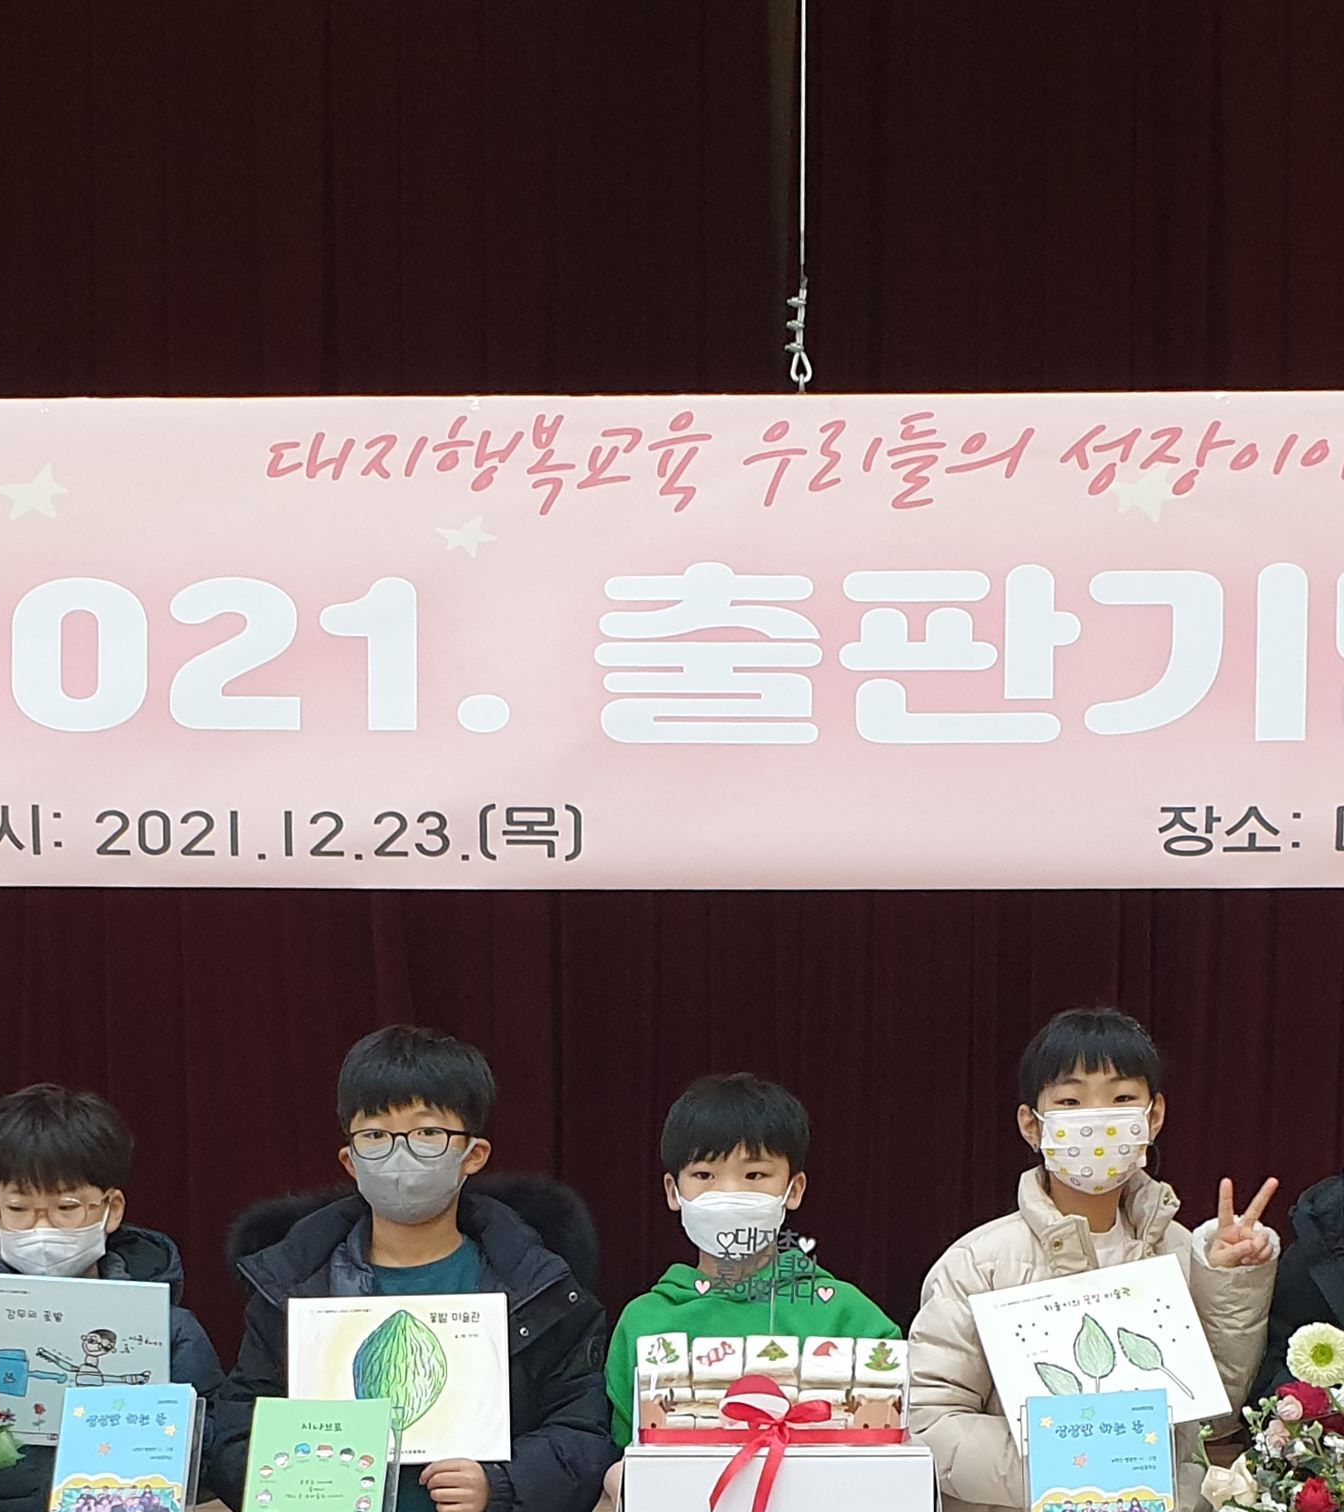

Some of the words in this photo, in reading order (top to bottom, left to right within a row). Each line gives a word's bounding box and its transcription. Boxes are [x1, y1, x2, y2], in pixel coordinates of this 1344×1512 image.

[267, 411, 701, 515] 대지행복교육
[743, 409, 1038, 511] 우리들의
[95, 800, 585, 864] 2021.12.23.(목)
[1156, 802, 1303, 859] 장소:
[735, 1227, 800, 1251] 대지초
[451, 1311, 480, 1323] 미술관
